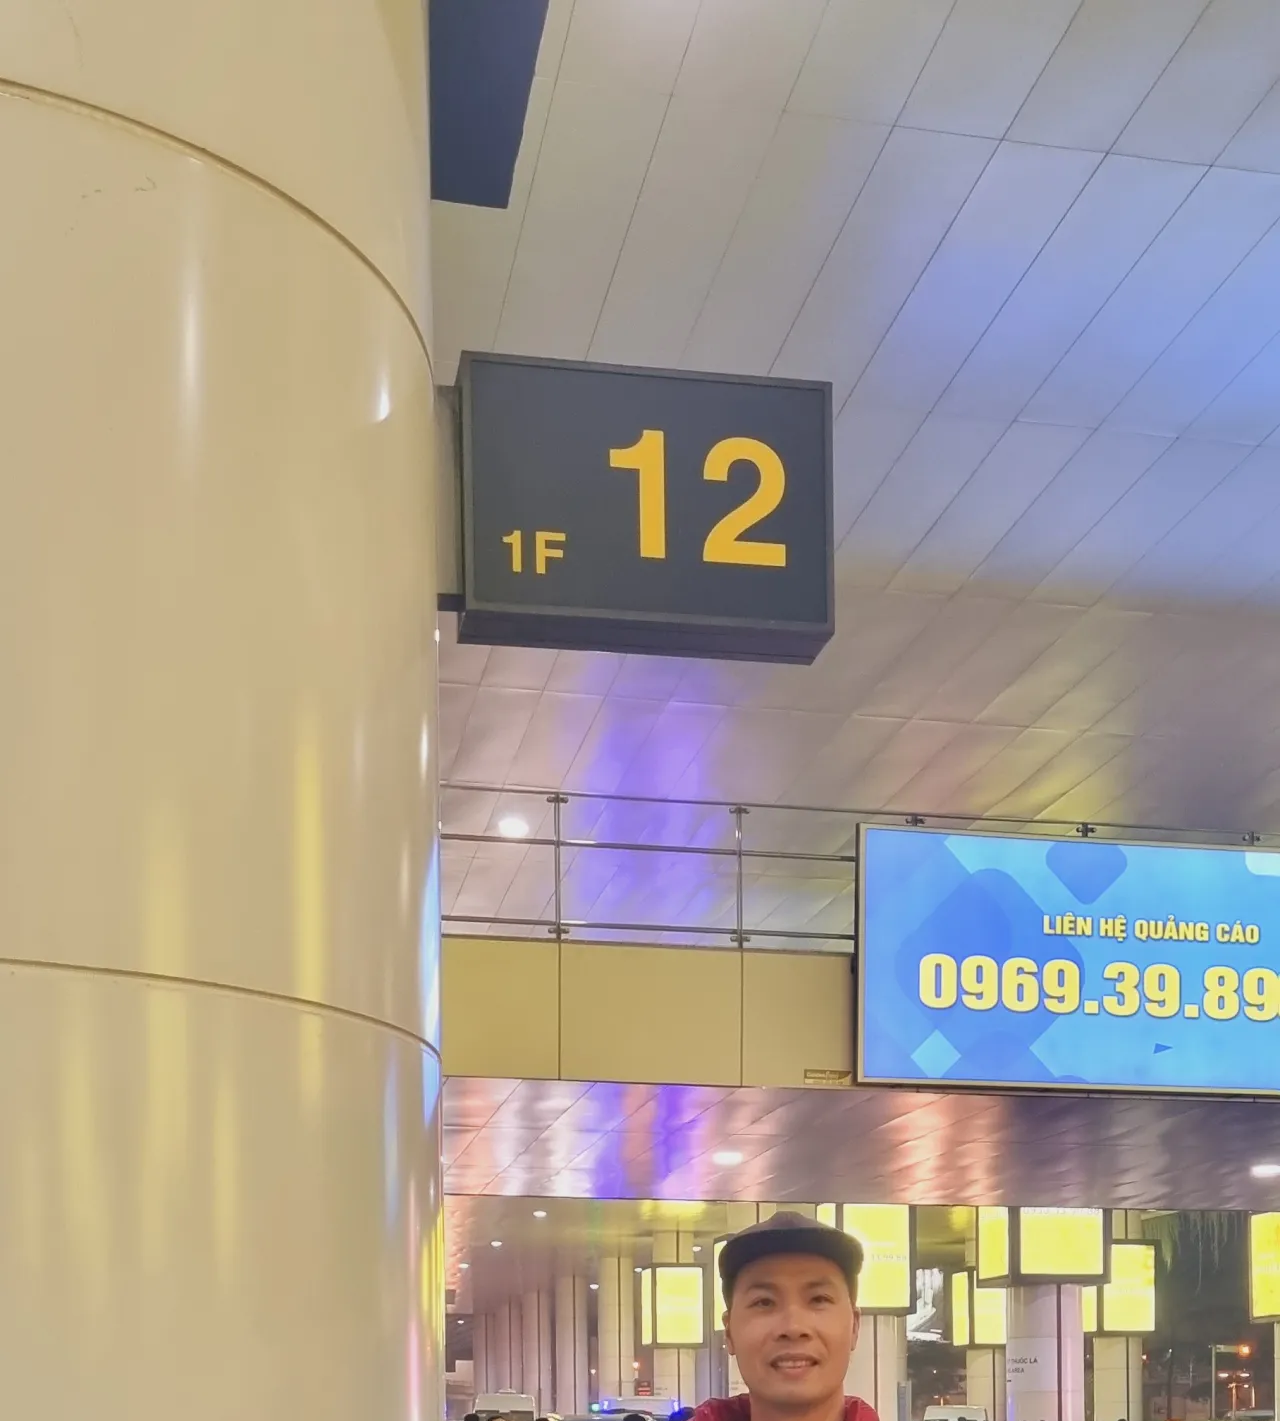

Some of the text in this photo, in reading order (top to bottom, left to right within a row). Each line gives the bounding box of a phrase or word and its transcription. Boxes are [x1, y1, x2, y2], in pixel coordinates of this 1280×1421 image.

[609, 429, 786, 567] 12
[502, 530, 566, 575] 1F
[1043, 912, 1260, 944] LIÊN HỆ QUẢNG CÁO
[918, 953, 1280, 1022] 0969.39.89
